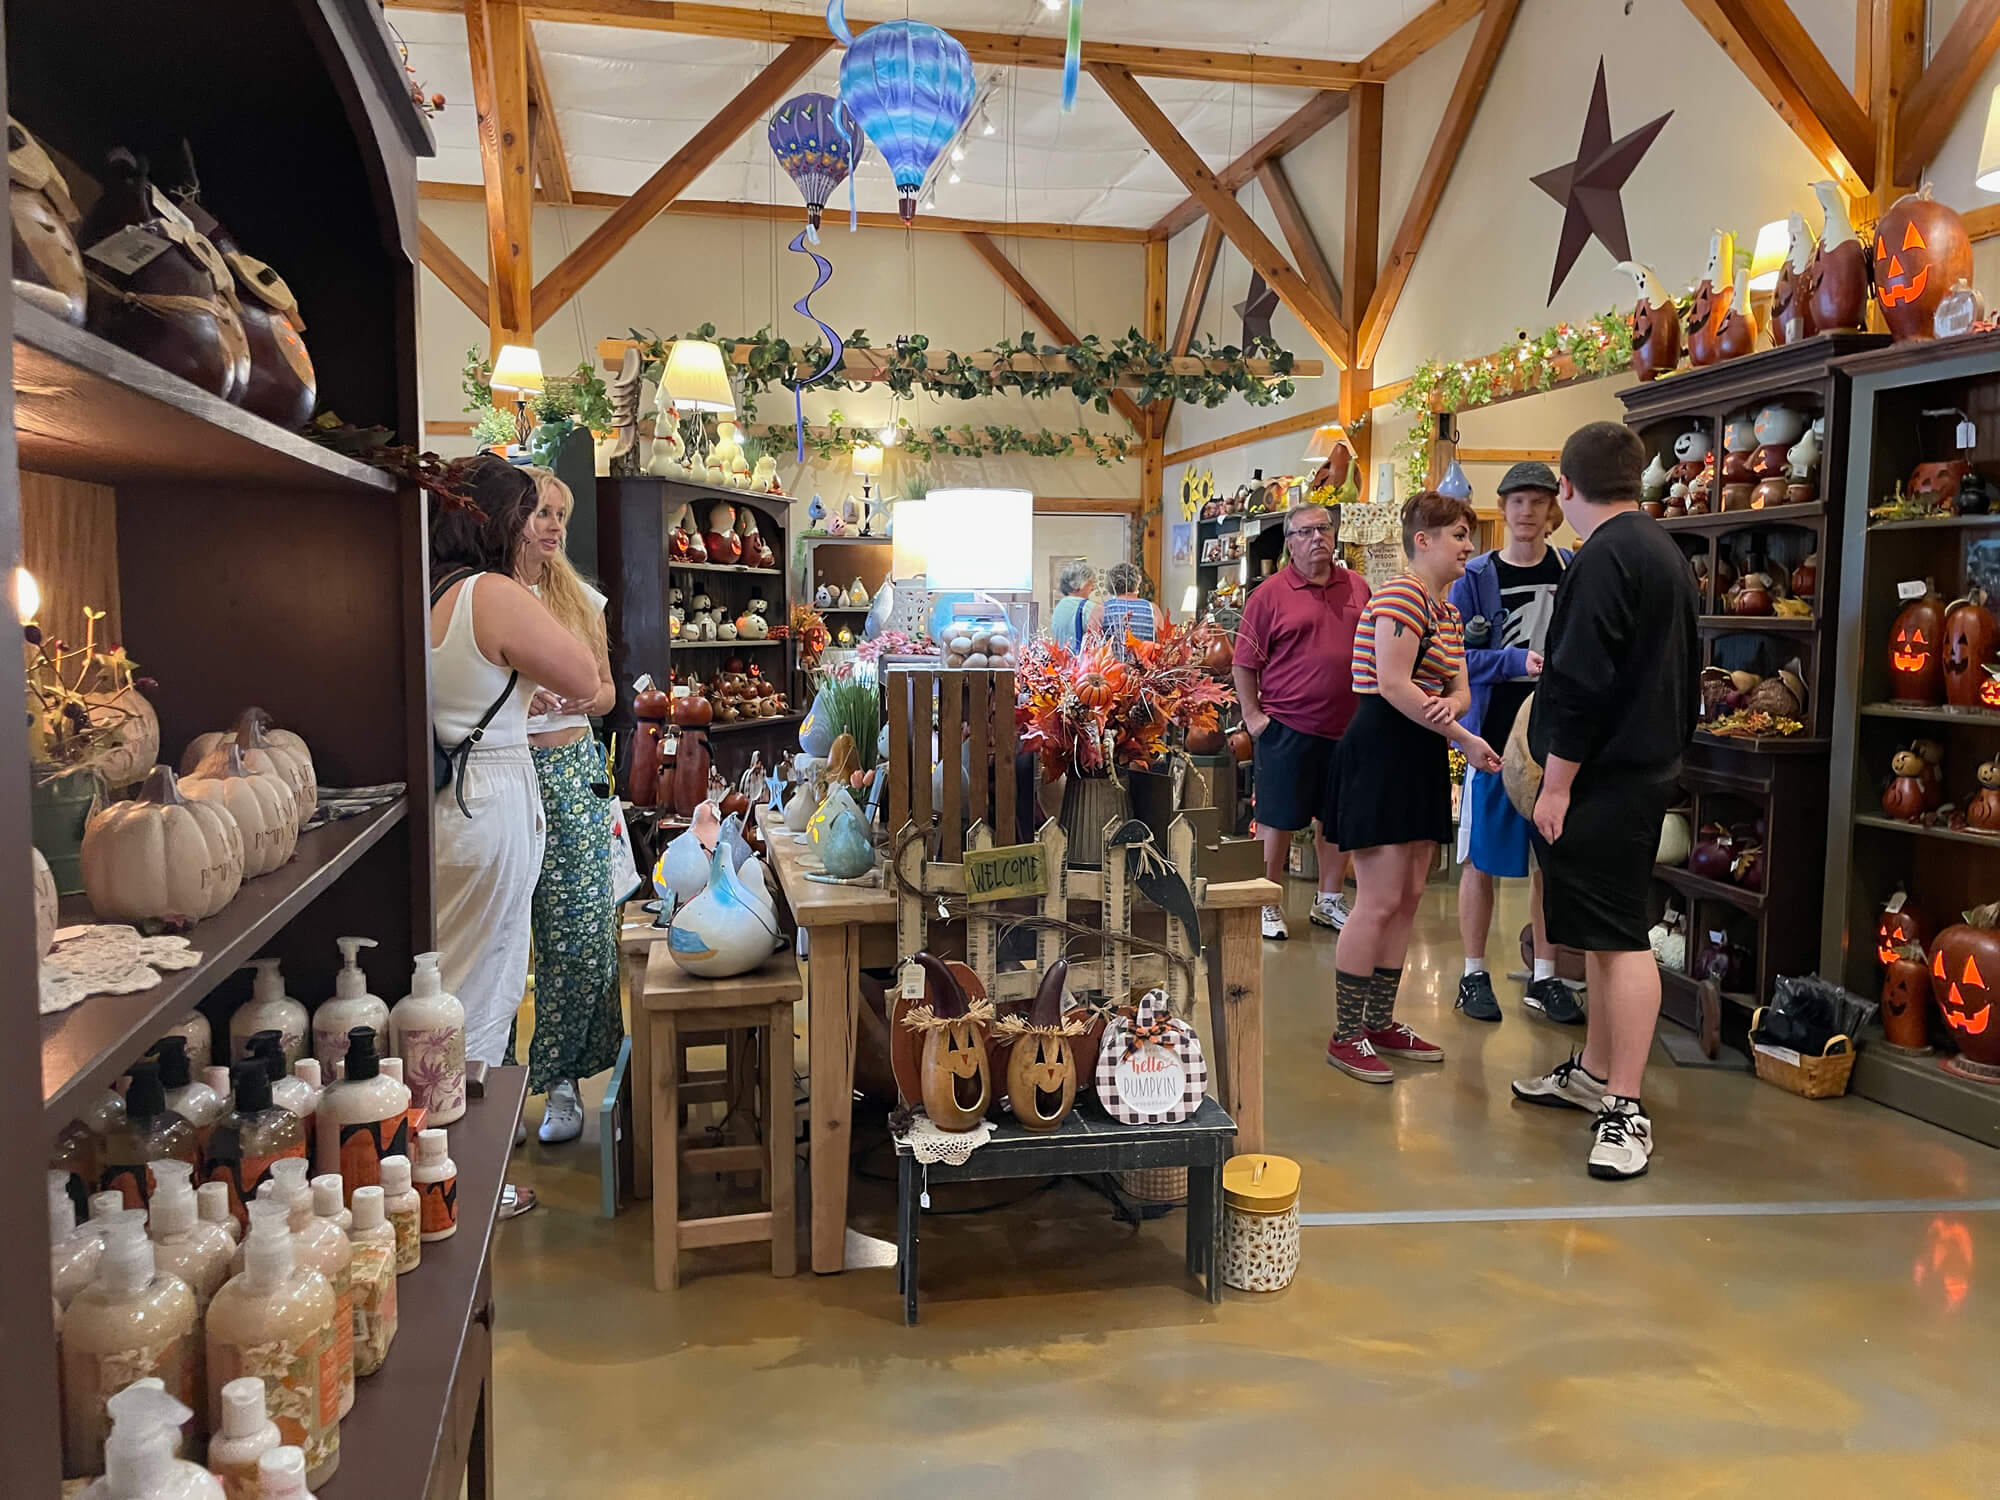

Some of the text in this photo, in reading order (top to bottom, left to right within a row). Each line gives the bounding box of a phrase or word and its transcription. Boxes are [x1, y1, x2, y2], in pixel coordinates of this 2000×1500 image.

[970, 856, 1040, 893] WELCOME
[1127, 1056, 1178, 1075] hello
[1123, 1076, 1177, 1098] PUMPKIN
